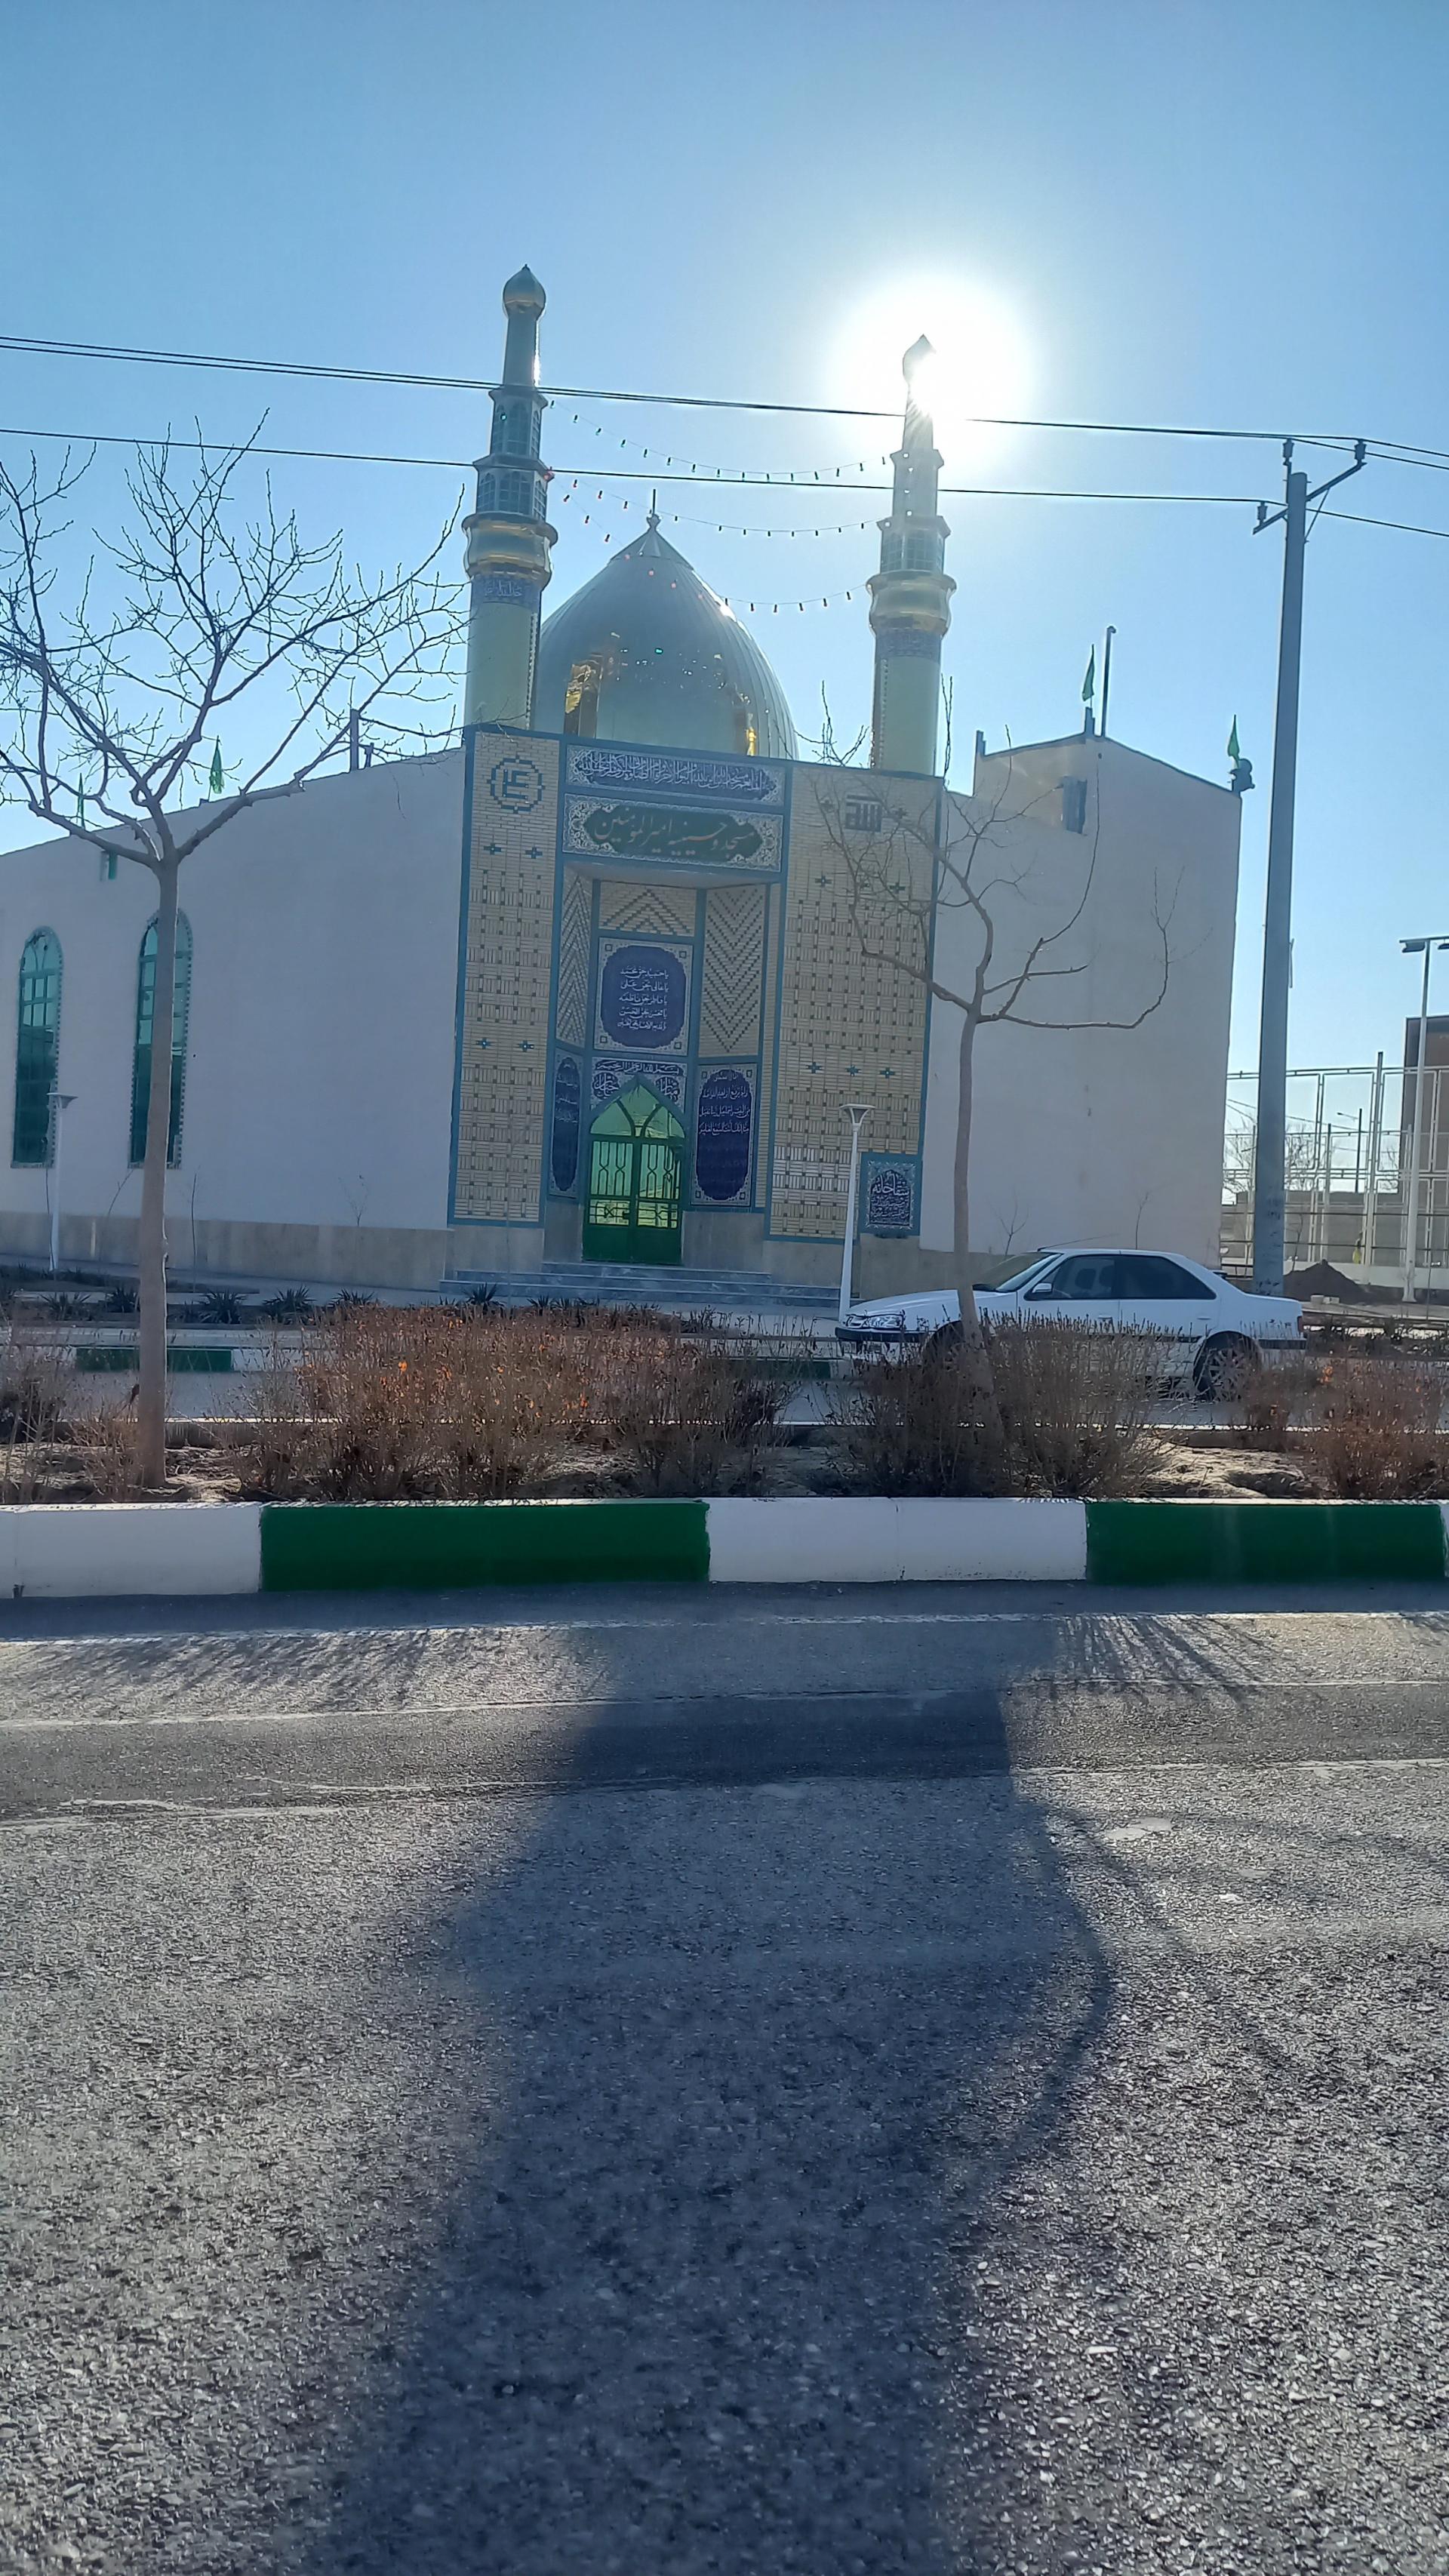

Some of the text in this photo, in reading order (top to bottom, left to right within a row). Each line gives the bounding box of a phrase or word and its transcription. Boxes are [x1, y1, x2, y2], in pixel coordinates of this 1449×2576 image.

[667, 821, 728, 856] حسینیه
[710, 838, 718, 851] و
[720, 832, 755, 858] مسجد
